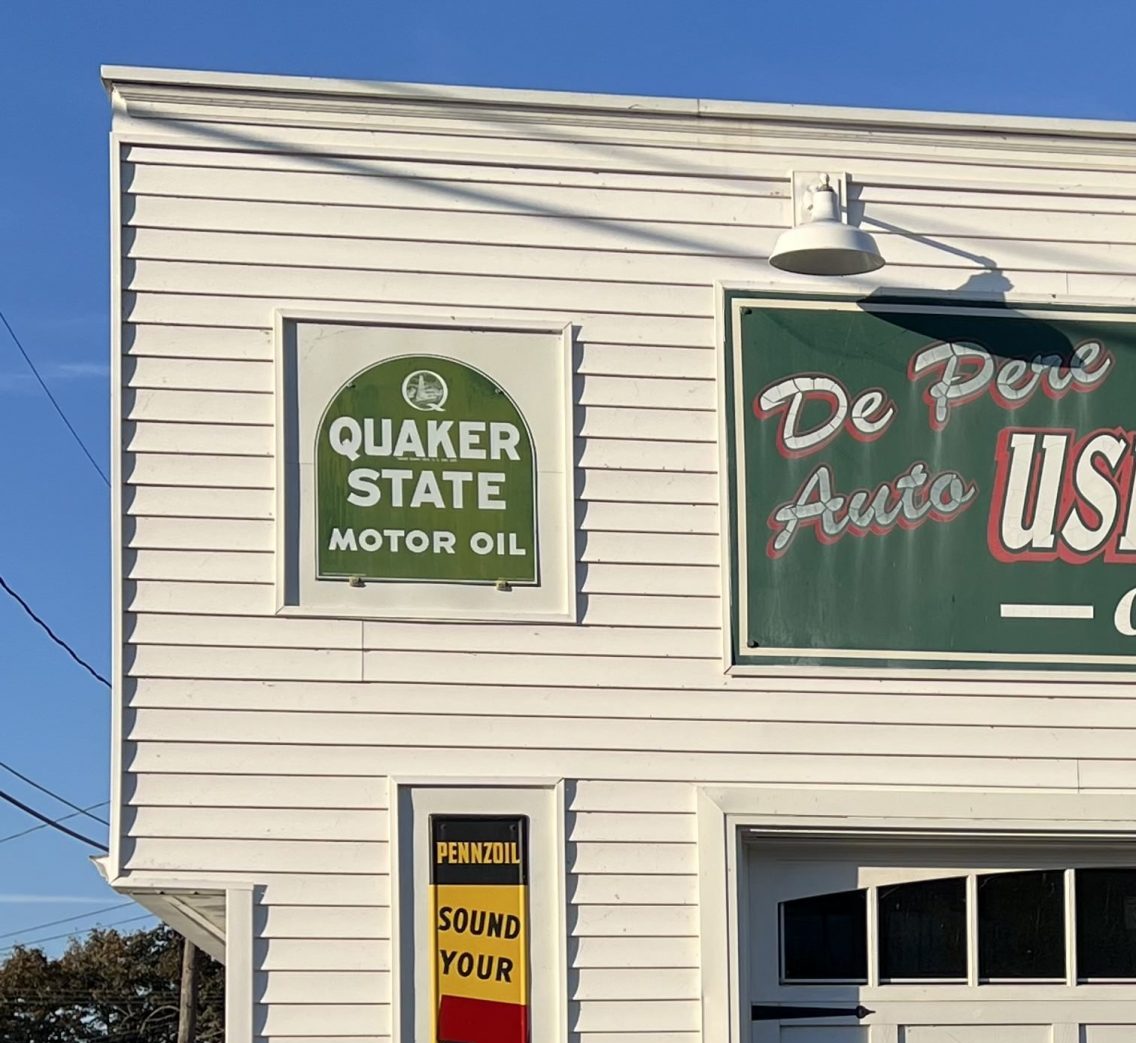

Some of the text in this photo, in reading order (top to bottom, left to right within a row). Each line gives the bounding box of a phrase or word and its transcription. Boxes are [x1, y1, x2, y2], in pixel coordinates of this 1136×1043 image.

[756, 340, 1112, 453] De Pere
[329, 416, 521, 462] QUAKER
[347, 468, 507, 510] STATE
[769, 462, 976, 554] Auto
[328, 528, 526, 556] MOTOR OIL
[436, 842, 521, 864] PENNZOIL
[438, 906, 521, 939] SOUND
[439, 949, 514, 983] YOUR
